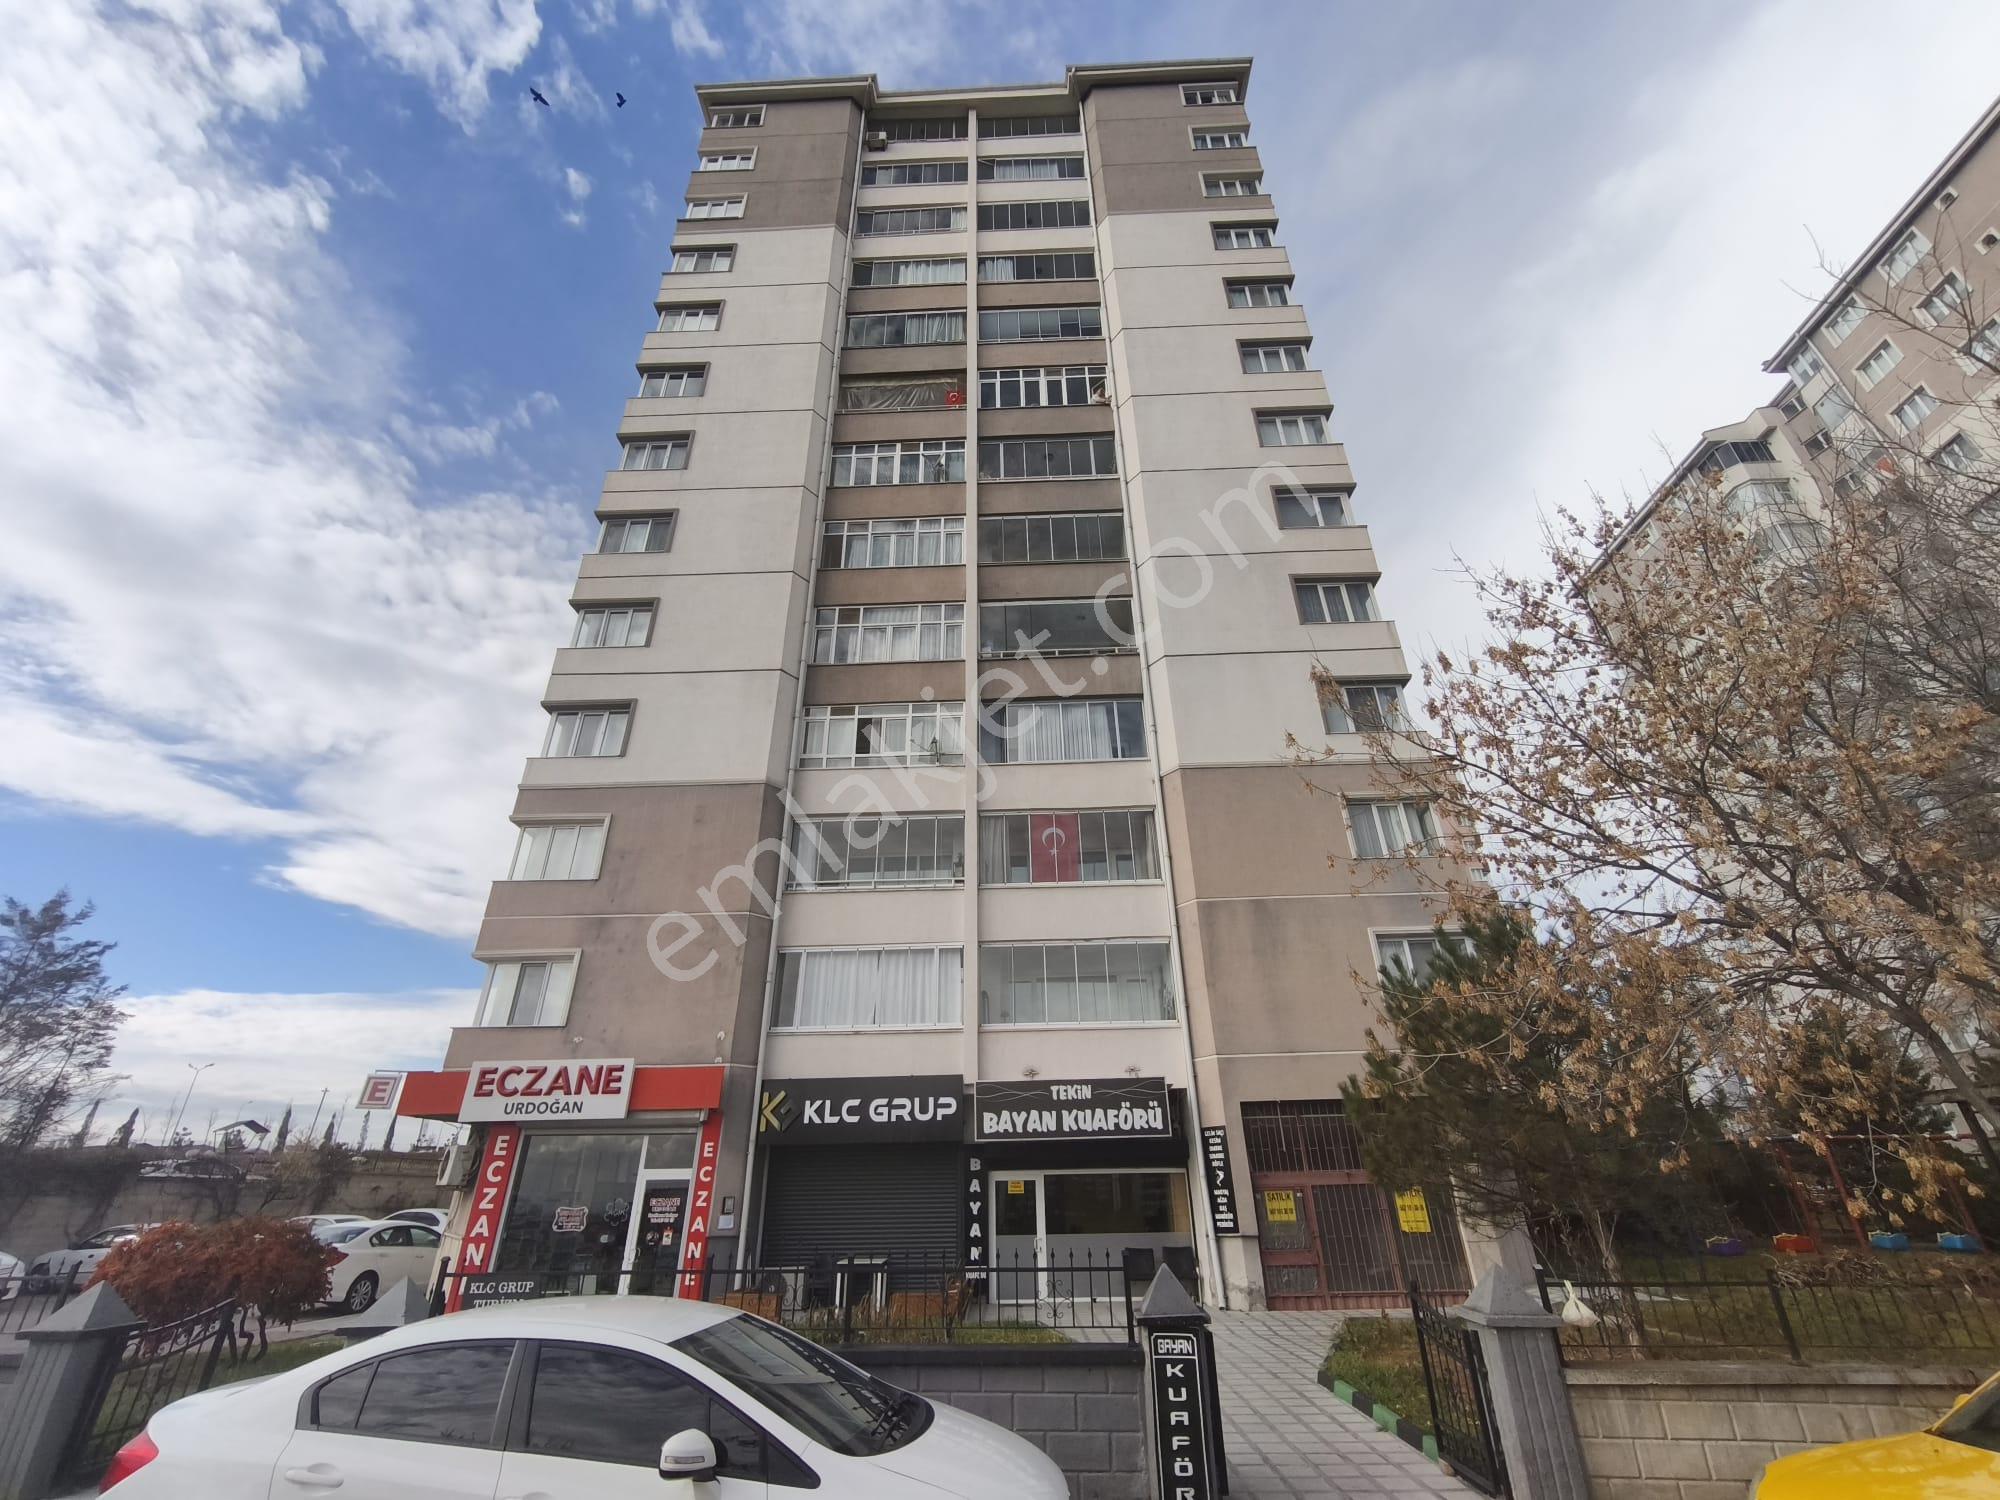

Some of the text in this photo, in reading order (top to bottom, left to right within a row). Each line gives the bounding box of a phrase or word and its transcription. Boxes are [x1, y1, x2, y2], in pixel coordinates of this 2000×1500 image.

[368, 1081, 390, 1101] E
[473, 1065, 625, 1098] ECZANE
[503, 1098, 583, 1115] URDOĞAN
[803, 1096, 957, 1124] KLC GRUP
[983, 1101, 1164, 1134] BAYAN KUAFÖRÜ
[458, 1135, 510, 1296] ECZAN
[969, 1158, 982, 1261] BAYAN
[469, 1281, 534, 1294] KLC GRUP
